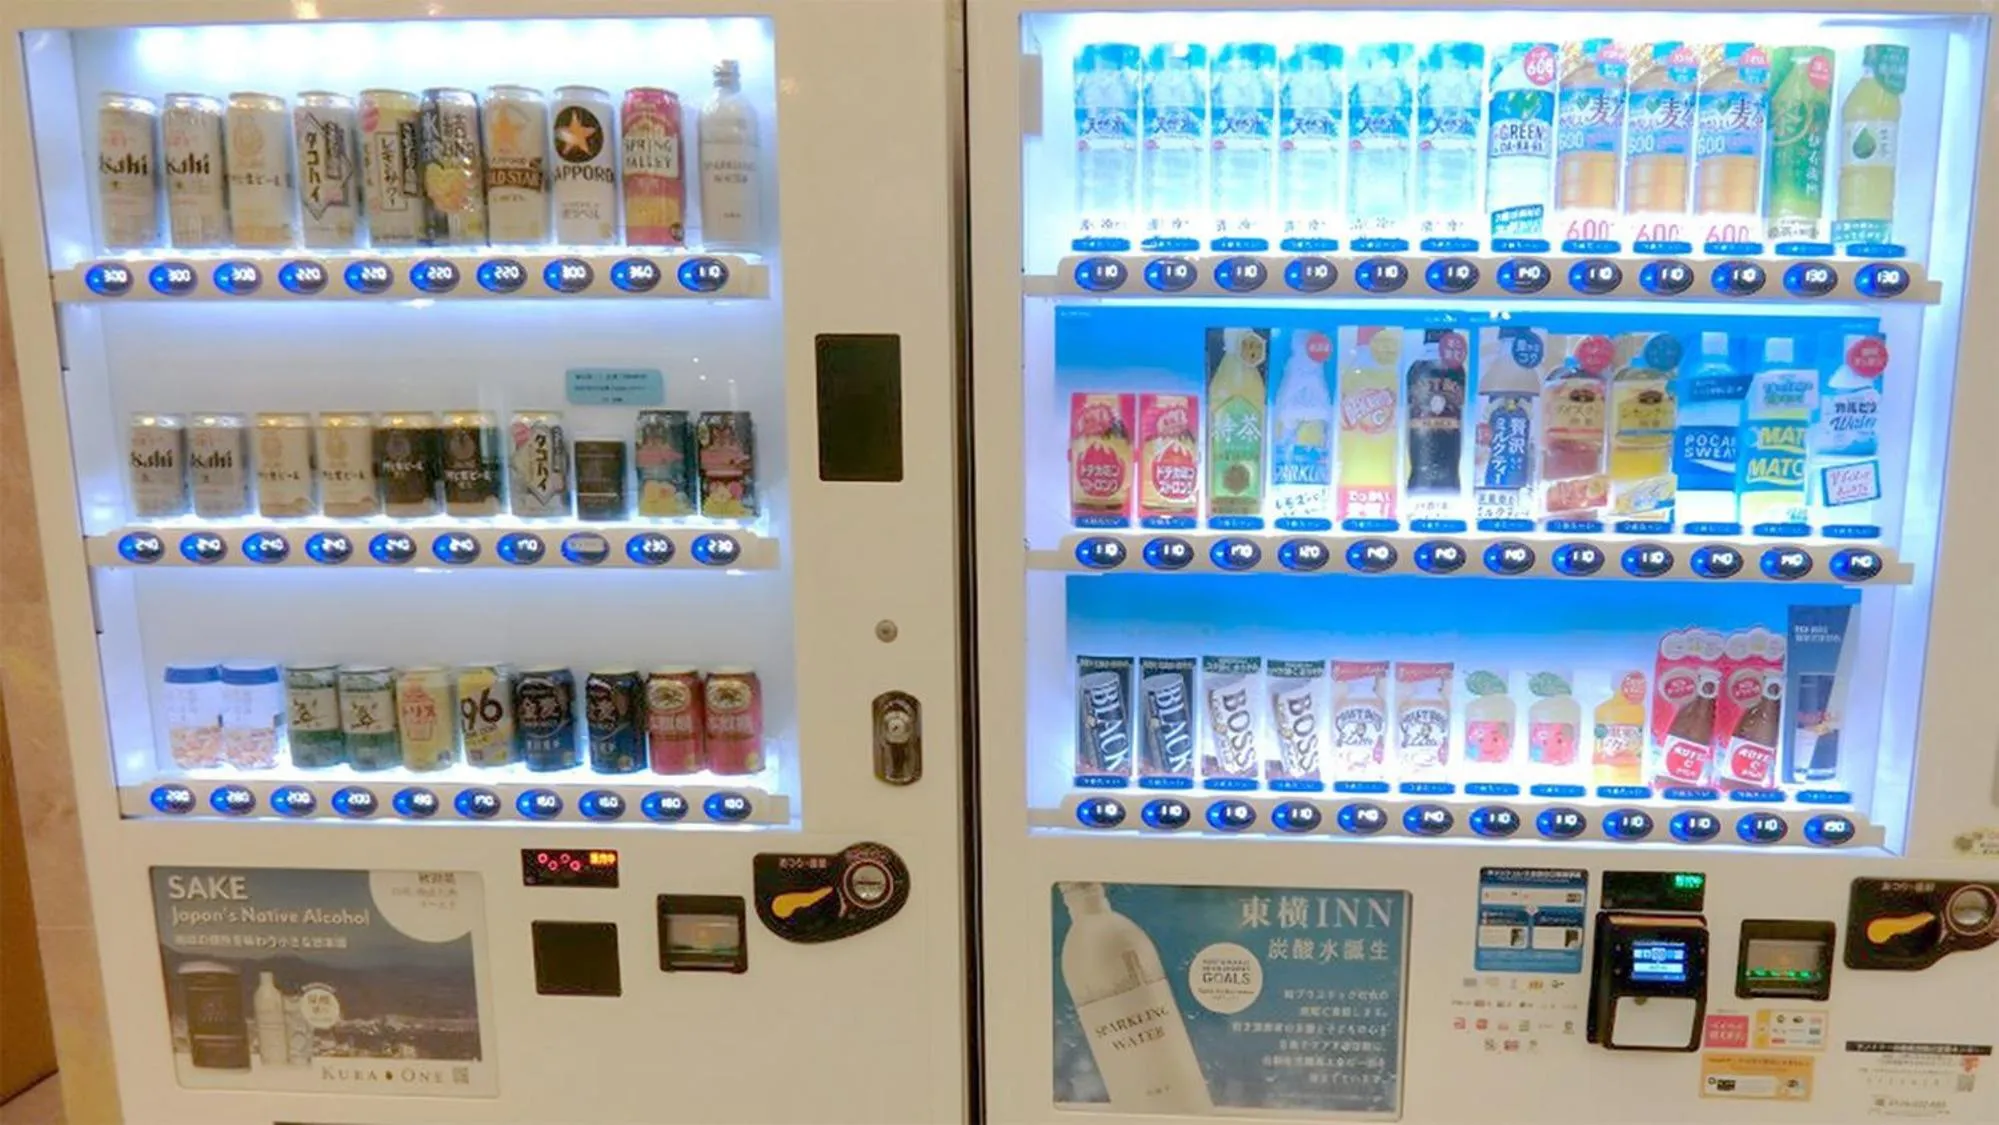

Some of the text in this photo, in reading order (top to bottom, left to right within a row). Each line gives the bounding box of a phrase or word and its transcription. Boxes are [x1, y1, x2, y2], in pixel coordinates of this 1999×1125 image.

[623, 138, 673, 154] SPRING
[1566, 219, 1610, 241] 600
[1211, 414, 1262, 442] 特茶
[460, 687, 503, 731] 96
[1092, 681, 1129, 772] BLACK
[1156, 682, 1194, 773] BLACK
[1222, 688, 1253, 769] BOSS
[1288, 692, 1319, 772] BOSS
[168, 875, 249, 900] SAKE
[241, 906, 299, 924] Native
[302, 908, 371, 927] Alcohol
[1235, 895, 1395, 929] 東横INN
[1267, 937, 1389, 965] 炭酸水誕生
[1202, 972, 1251, 985] GOALS
[1095, 1005, 1169, 1040] SPARKLING
[1111, 1028, 1166, 1052] WATER
